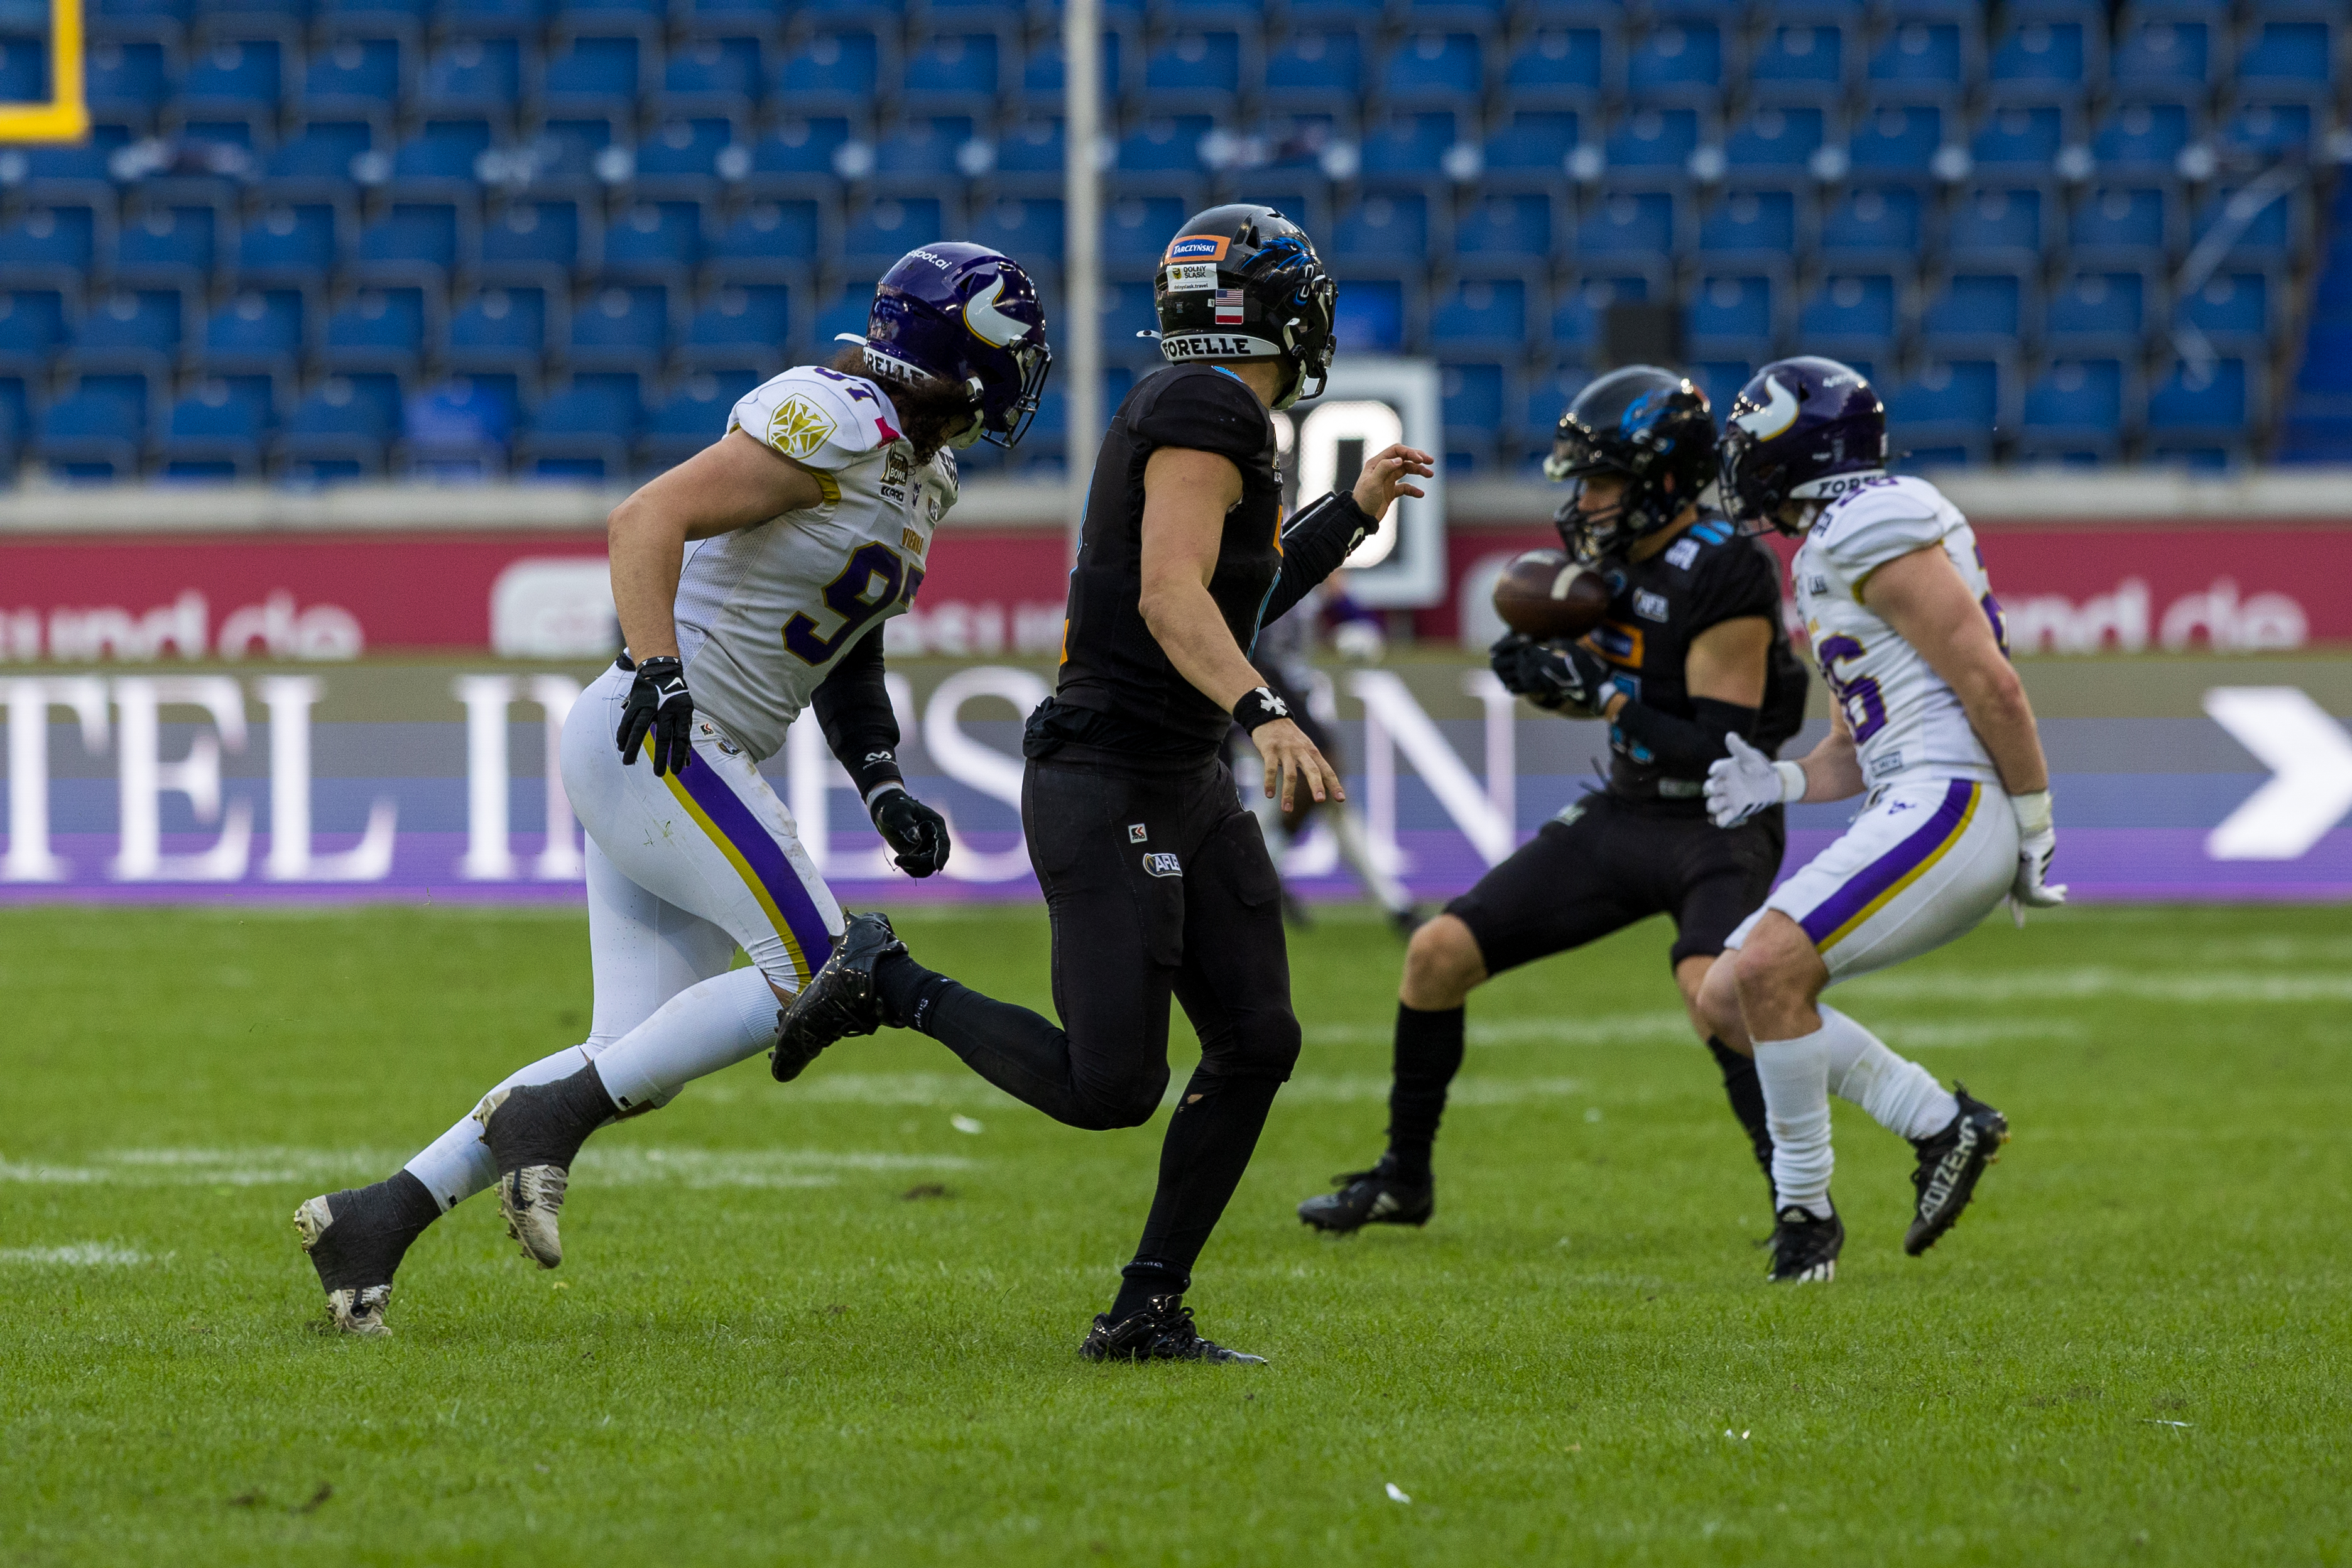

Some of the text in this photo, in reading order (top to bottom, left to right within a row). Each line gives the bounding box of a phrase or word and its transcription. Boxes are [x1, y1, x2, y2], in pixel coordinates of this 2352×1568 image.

[1173, 243, 1215, 255] TARCZYŃSKI
[1162, 337, 1251, 359] FORELLE
[890, 467, 906, 482] BOWL
[0, 674, 397, 882] TEL
